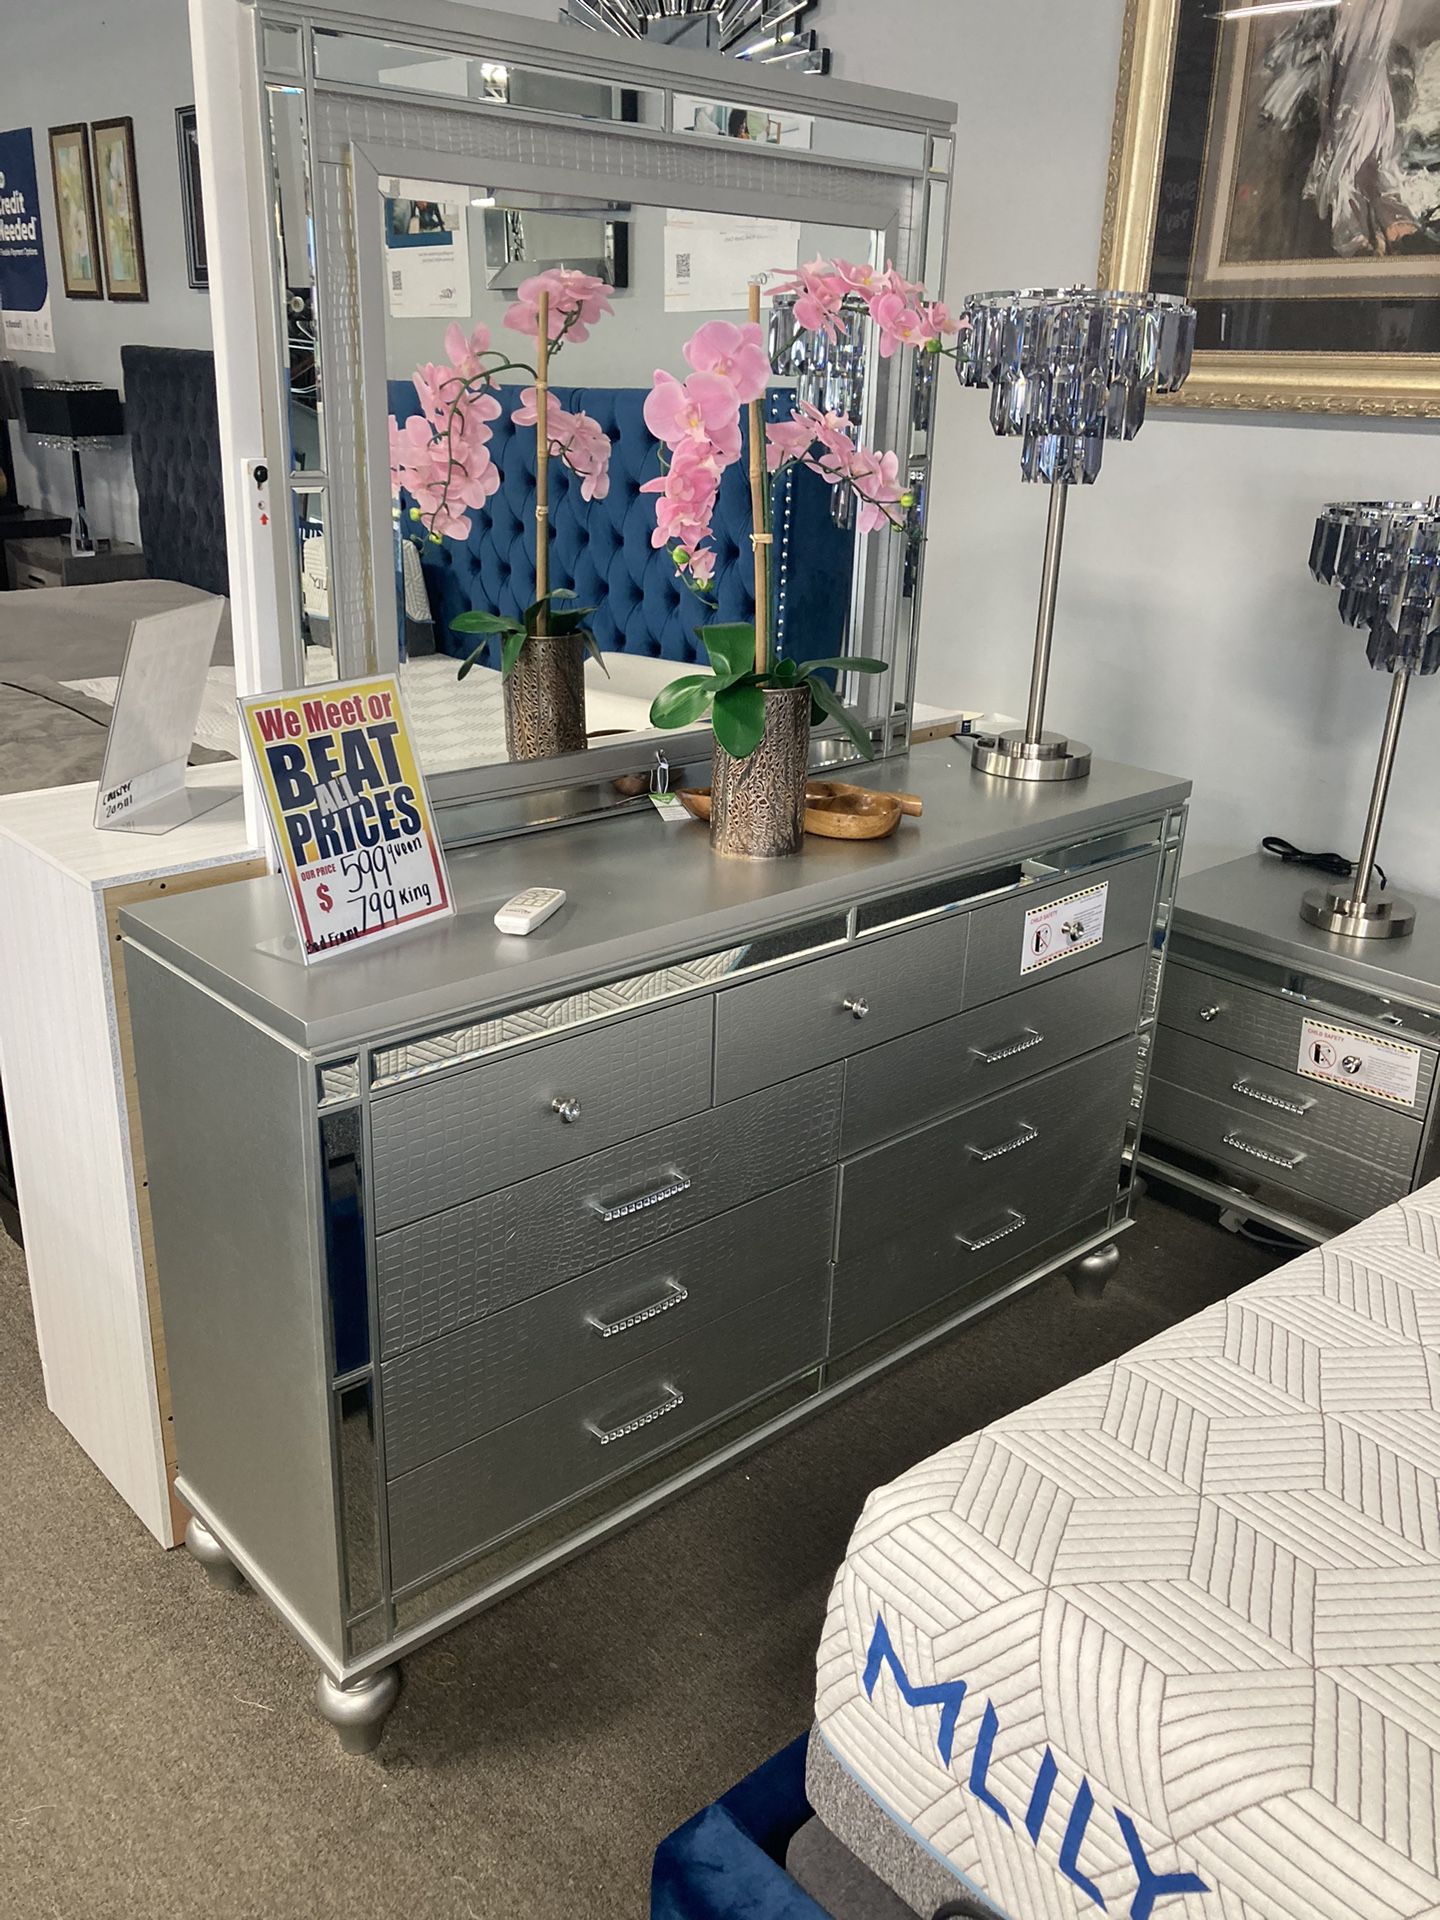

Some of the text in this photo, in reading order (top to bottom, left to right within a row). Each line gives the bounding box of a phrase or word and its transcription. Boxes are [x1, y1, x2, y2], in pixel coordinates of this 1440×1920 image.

[0, 190, 25, 214] redit
[255, 692, 392, 742] We Meet or
[265, 721, 403, 811] BEAT
[314, 774, 360, 816] ALL
[284, 785, 422, 867] PRICES
[301, 864, 336, 881] OUR PRICE
[340, 846, 392, 892] 599
[316, 883, 334, 913] $
[347, 890, 399, 932] 799
[1308, 1028, 1344, 1042] CHILD SAFETY
[862, 1610, 1211, 1920] MLILY
